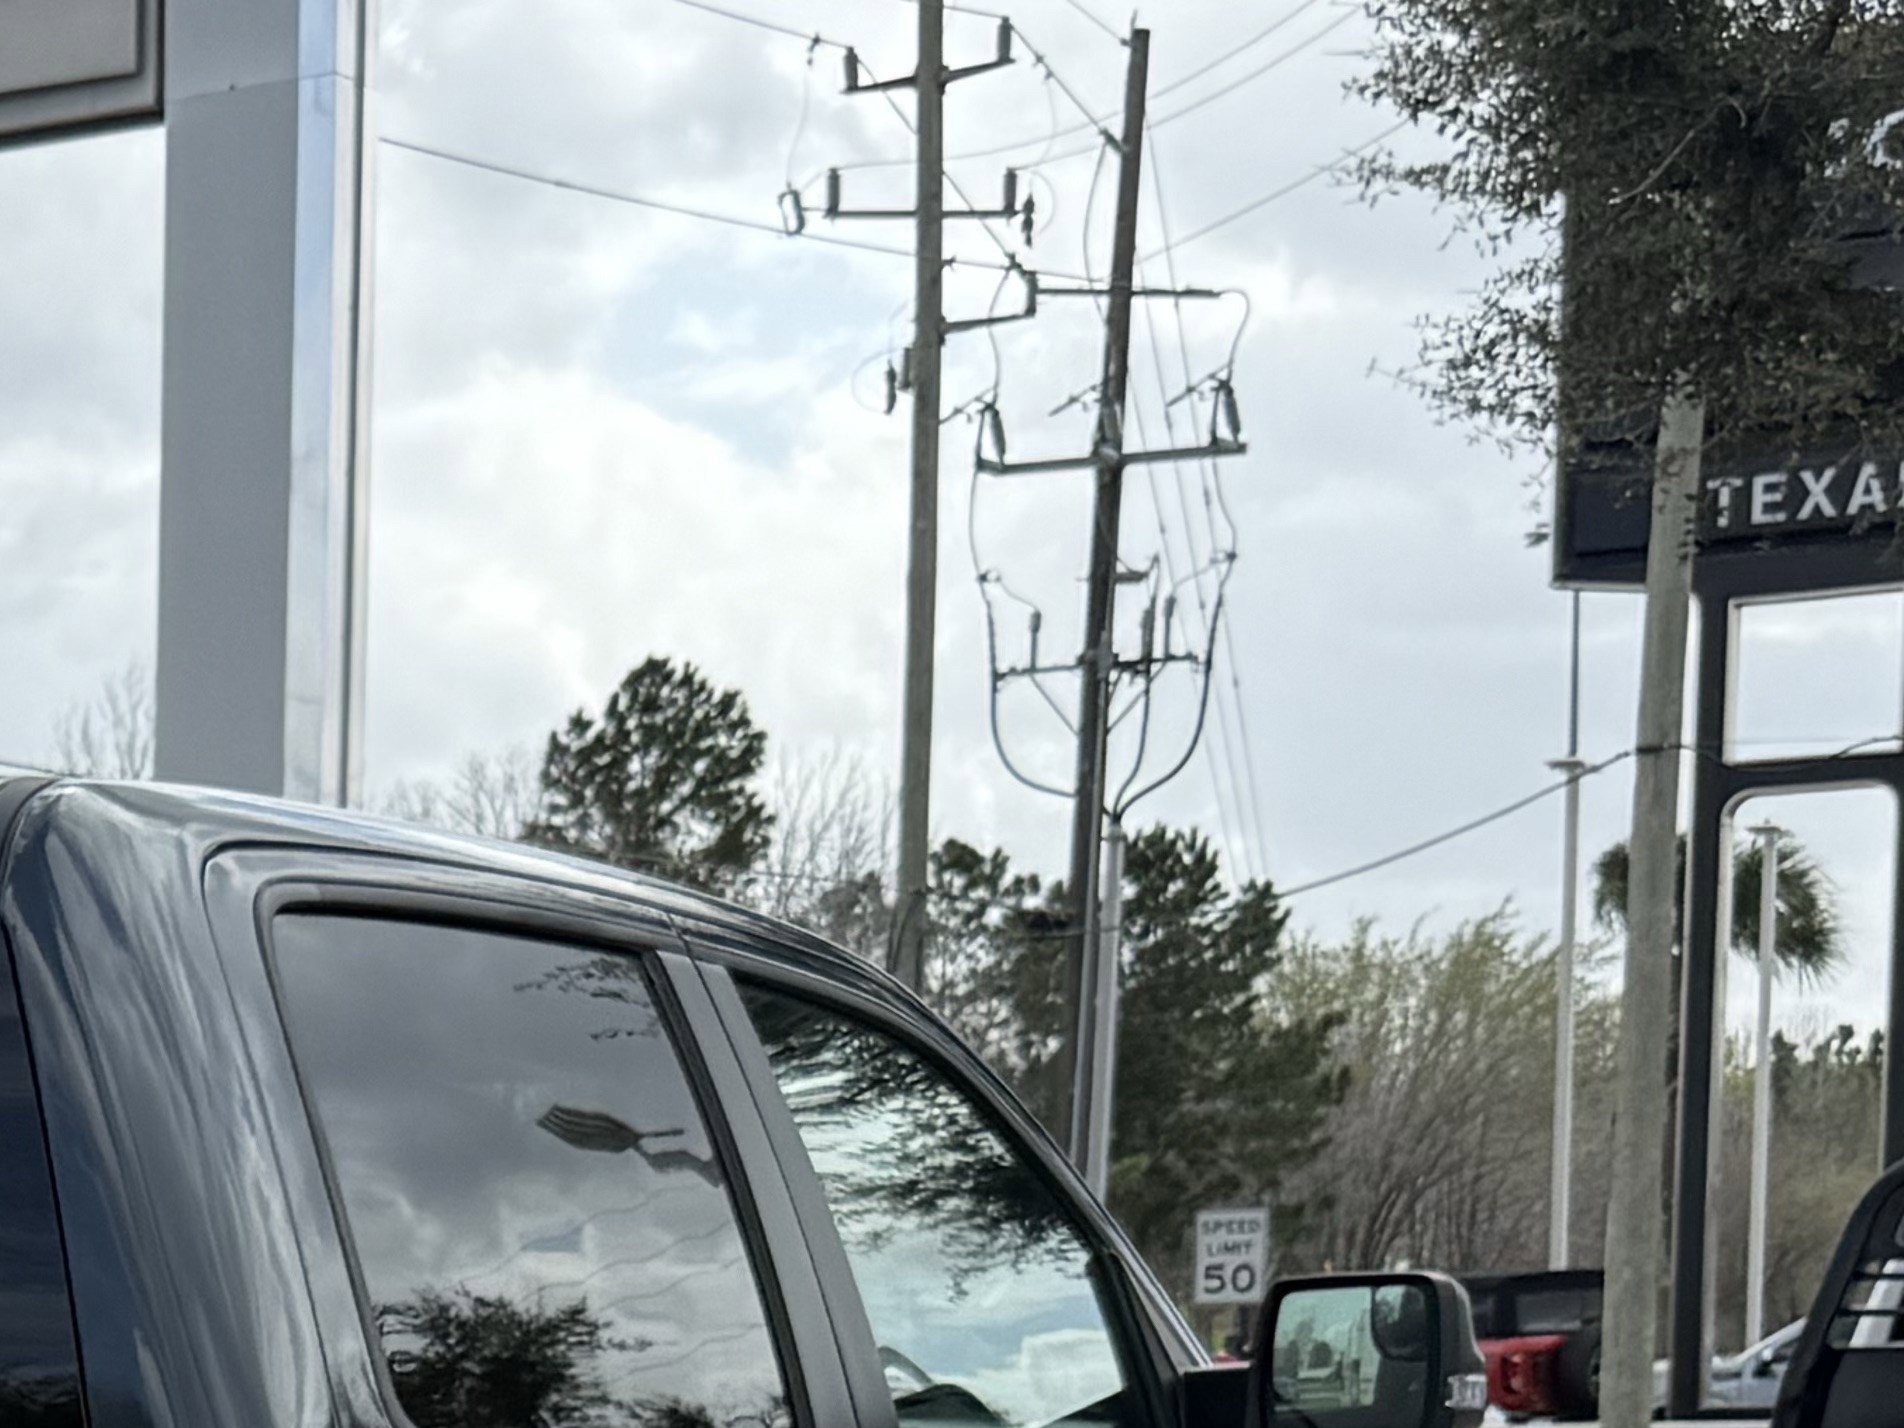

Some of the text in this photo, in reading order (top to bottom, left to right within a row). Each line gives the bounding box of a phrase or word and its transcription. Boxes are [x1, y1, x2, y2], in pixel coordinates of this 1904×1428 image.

[1706, 461, 1904, 528] TEXA
[1202, 1218, 1261, 1235] SPEED
[1206, 1239, 1253, 1257] LIMIT
[1204, 1263, 1256, 1294] 50
